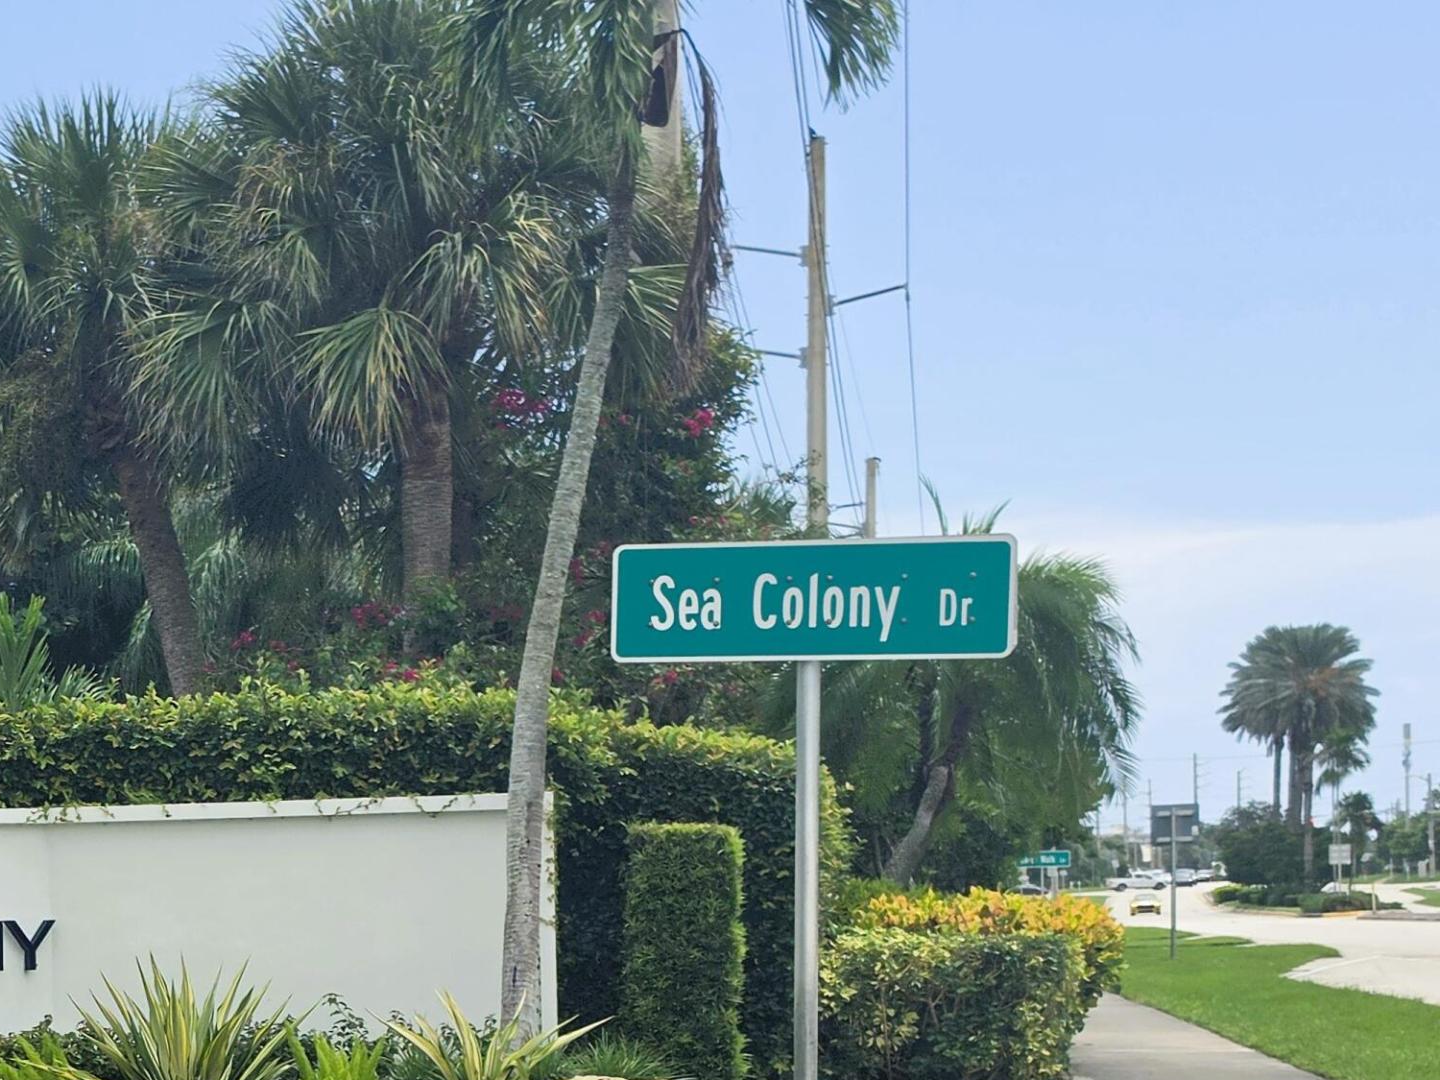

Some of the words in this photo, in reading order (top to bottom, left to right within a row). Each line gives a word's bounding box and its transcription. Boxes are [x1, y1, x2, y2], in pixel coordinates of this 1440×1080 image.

[649, 574, 723, 632] Sea
[752, 572, 901, 643] Colony
[938, 588, 973, 627] Dr
